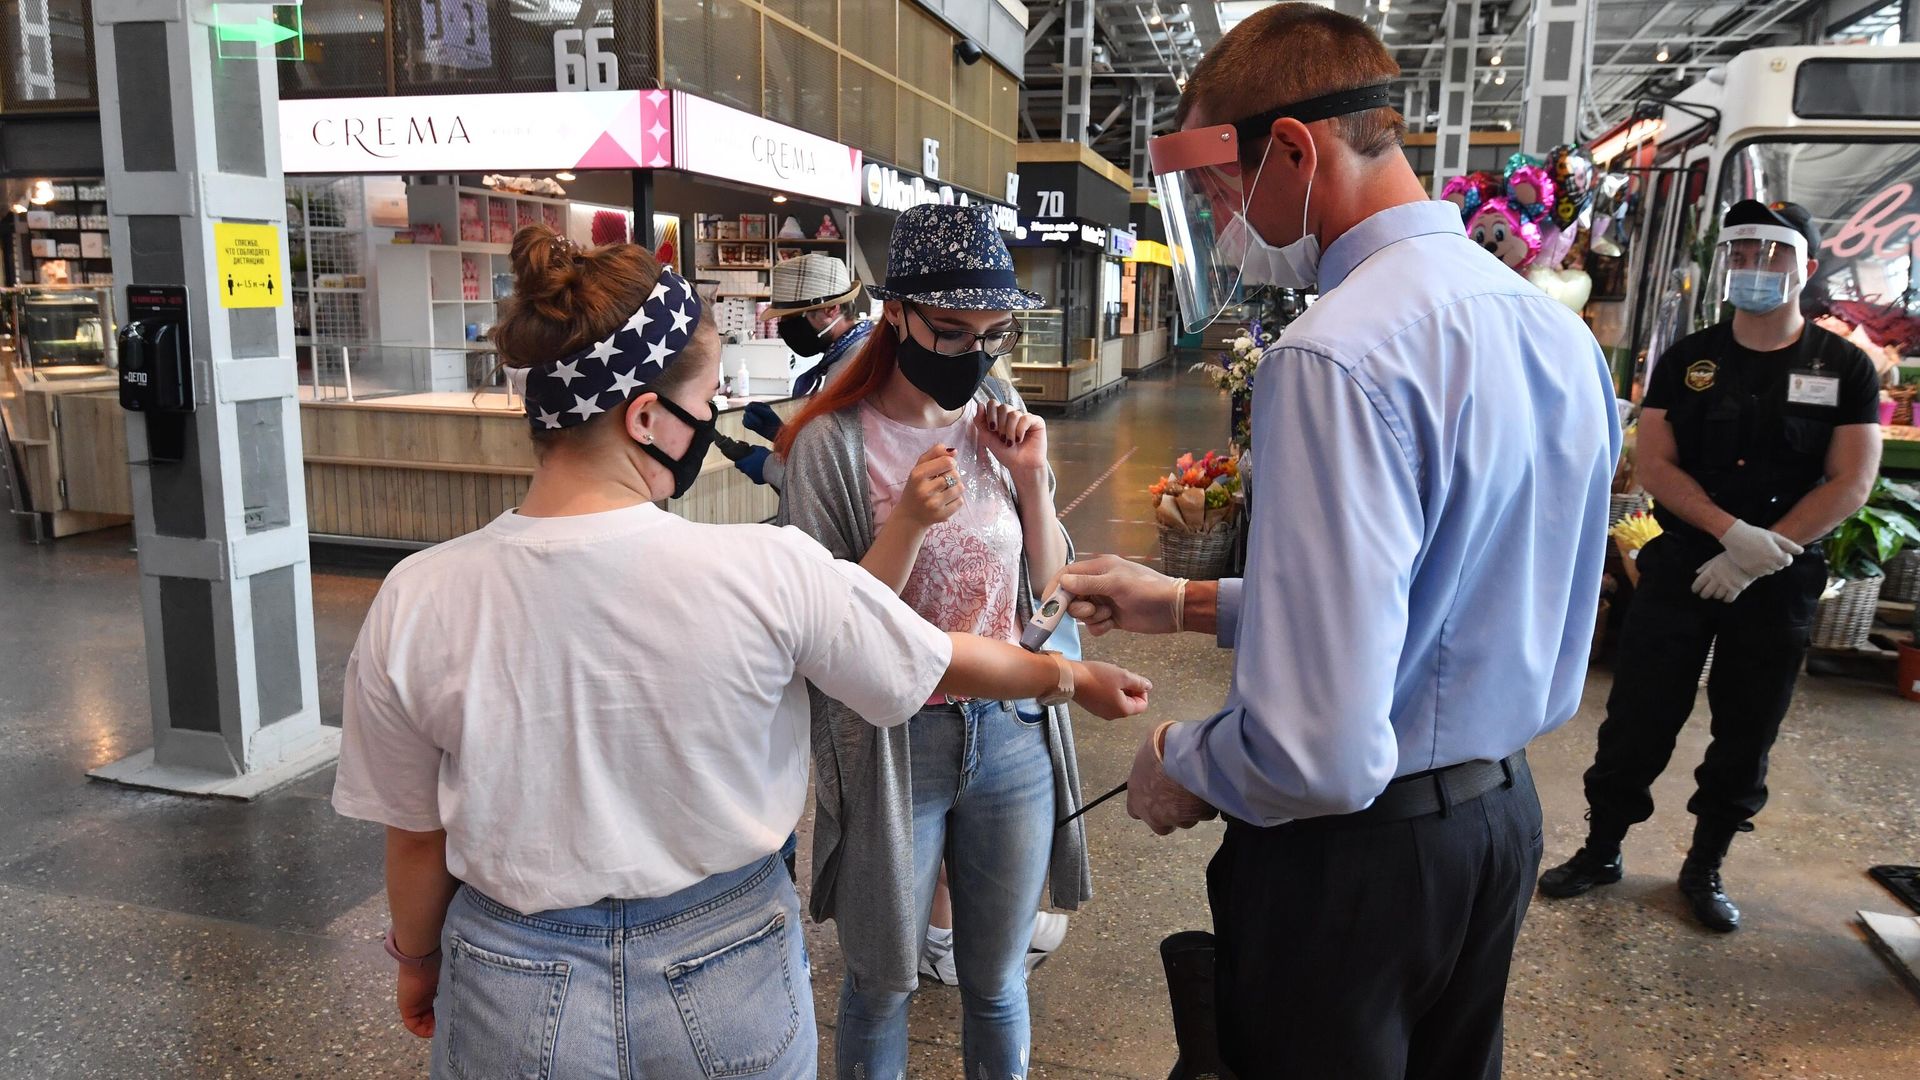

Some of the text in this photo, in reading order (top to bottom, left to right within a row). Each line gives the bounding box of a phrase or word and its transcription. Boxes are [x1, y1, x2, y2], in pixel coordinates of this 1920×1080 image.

[553, 27, 620, 92] 66
[312, 115, 471, 158] CREMA
[752, 135, 816, 180] CREMA
[1036, 190, 1065, 218] 70
[237, 248, 270, 256] СОБЛЮДАЕТЕ
[128, 371, 148, 383] ДЕПО
